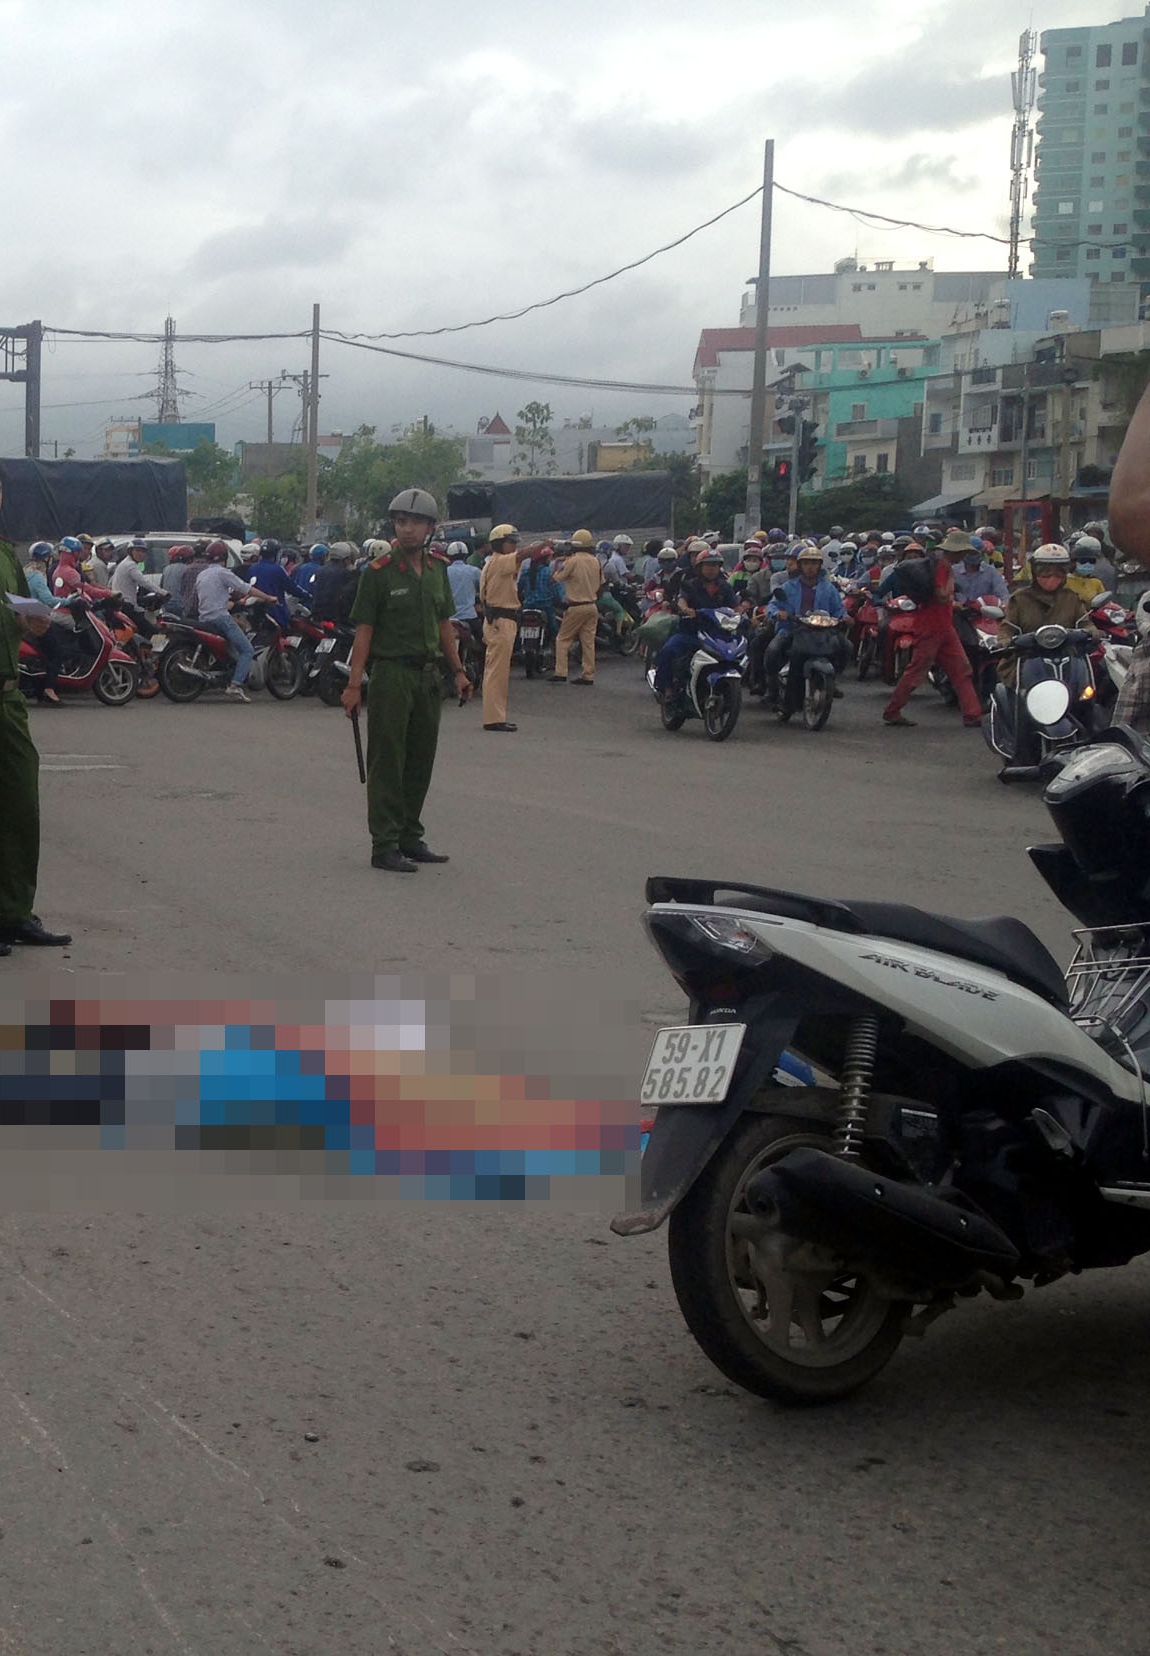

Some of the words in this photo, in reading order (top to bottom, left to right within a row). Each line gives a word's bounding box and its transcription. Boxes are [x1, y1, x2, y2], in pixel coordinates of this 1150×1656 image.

[710, 1007, 737, 1015] HONDA
[661, 1029, 727, 1065] 59-X1
[642, 1066, 726, 1100] 585.82
